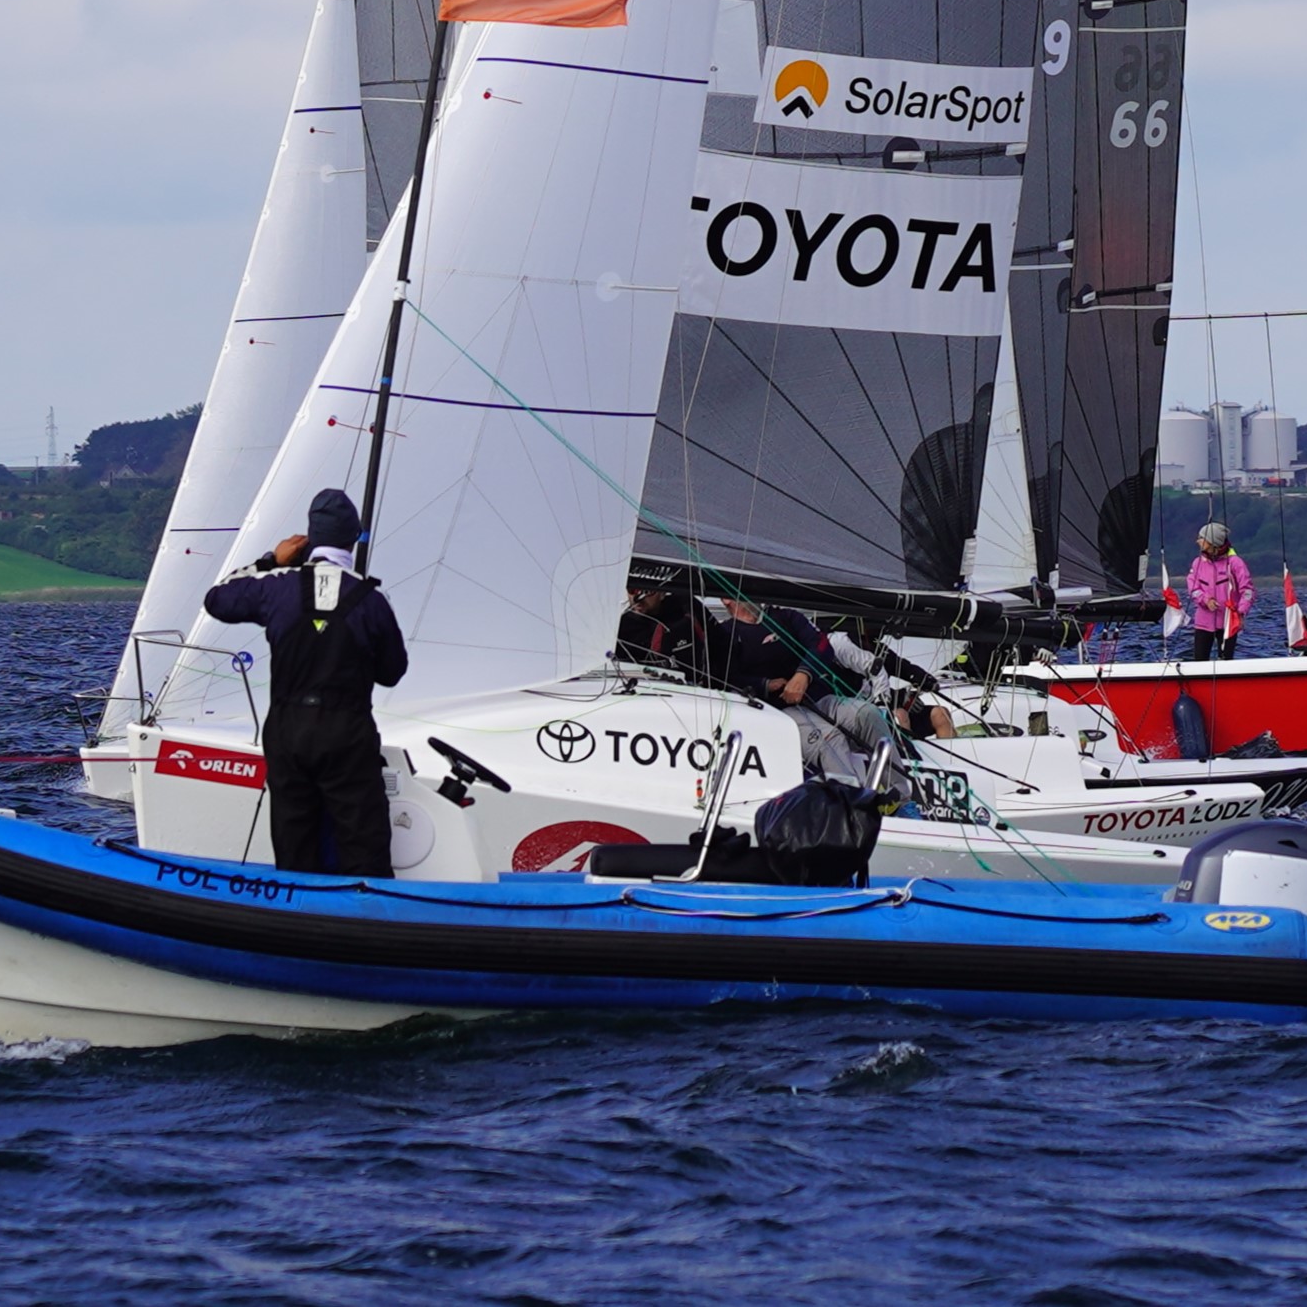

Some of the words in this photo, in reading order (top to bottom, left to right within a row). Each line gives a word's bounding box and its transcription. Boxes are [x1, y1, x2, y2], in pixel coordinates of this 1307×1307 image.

[845, 77, 1026, 131] SolarSpot
[1109, 99, 1170, 149] 66
[691, 196, 996, 293] OYOTA
[199, 758, 257, 777] ORLEN
[605, 730, 767, 778] TOYOA
[1083, 807, 1185, 834] TOYOTA
[156, 862, 219, 892] POL
